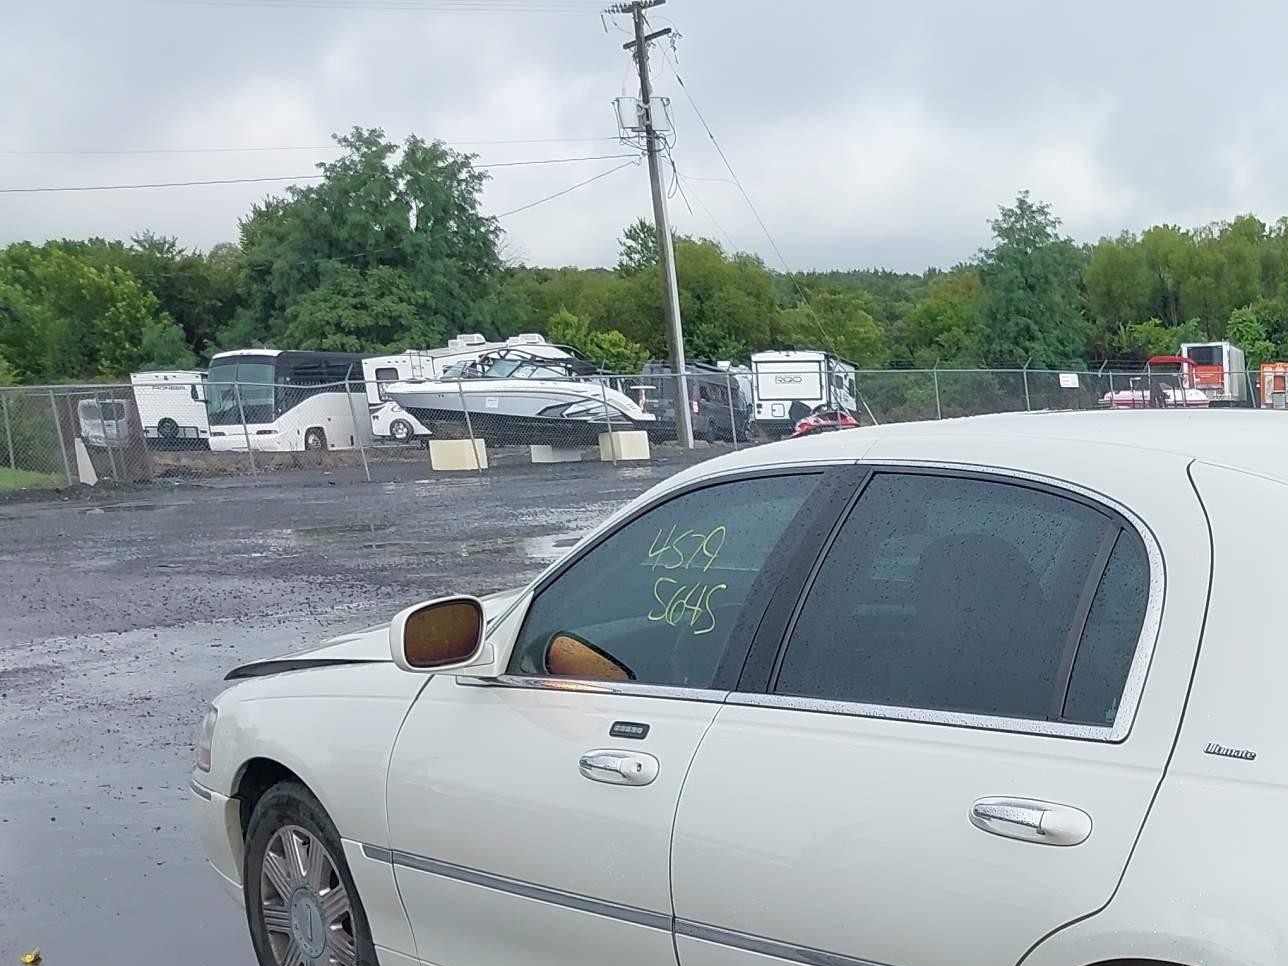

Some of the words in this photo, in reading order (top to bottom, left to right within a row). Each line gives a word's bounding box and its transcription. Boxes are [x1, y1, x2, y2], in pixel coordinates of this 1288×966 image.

[648, 523, 726, 573] 4579
[647, 577, 727, 635] 5645
[1203, 743, 1257, 760] Ultimate
